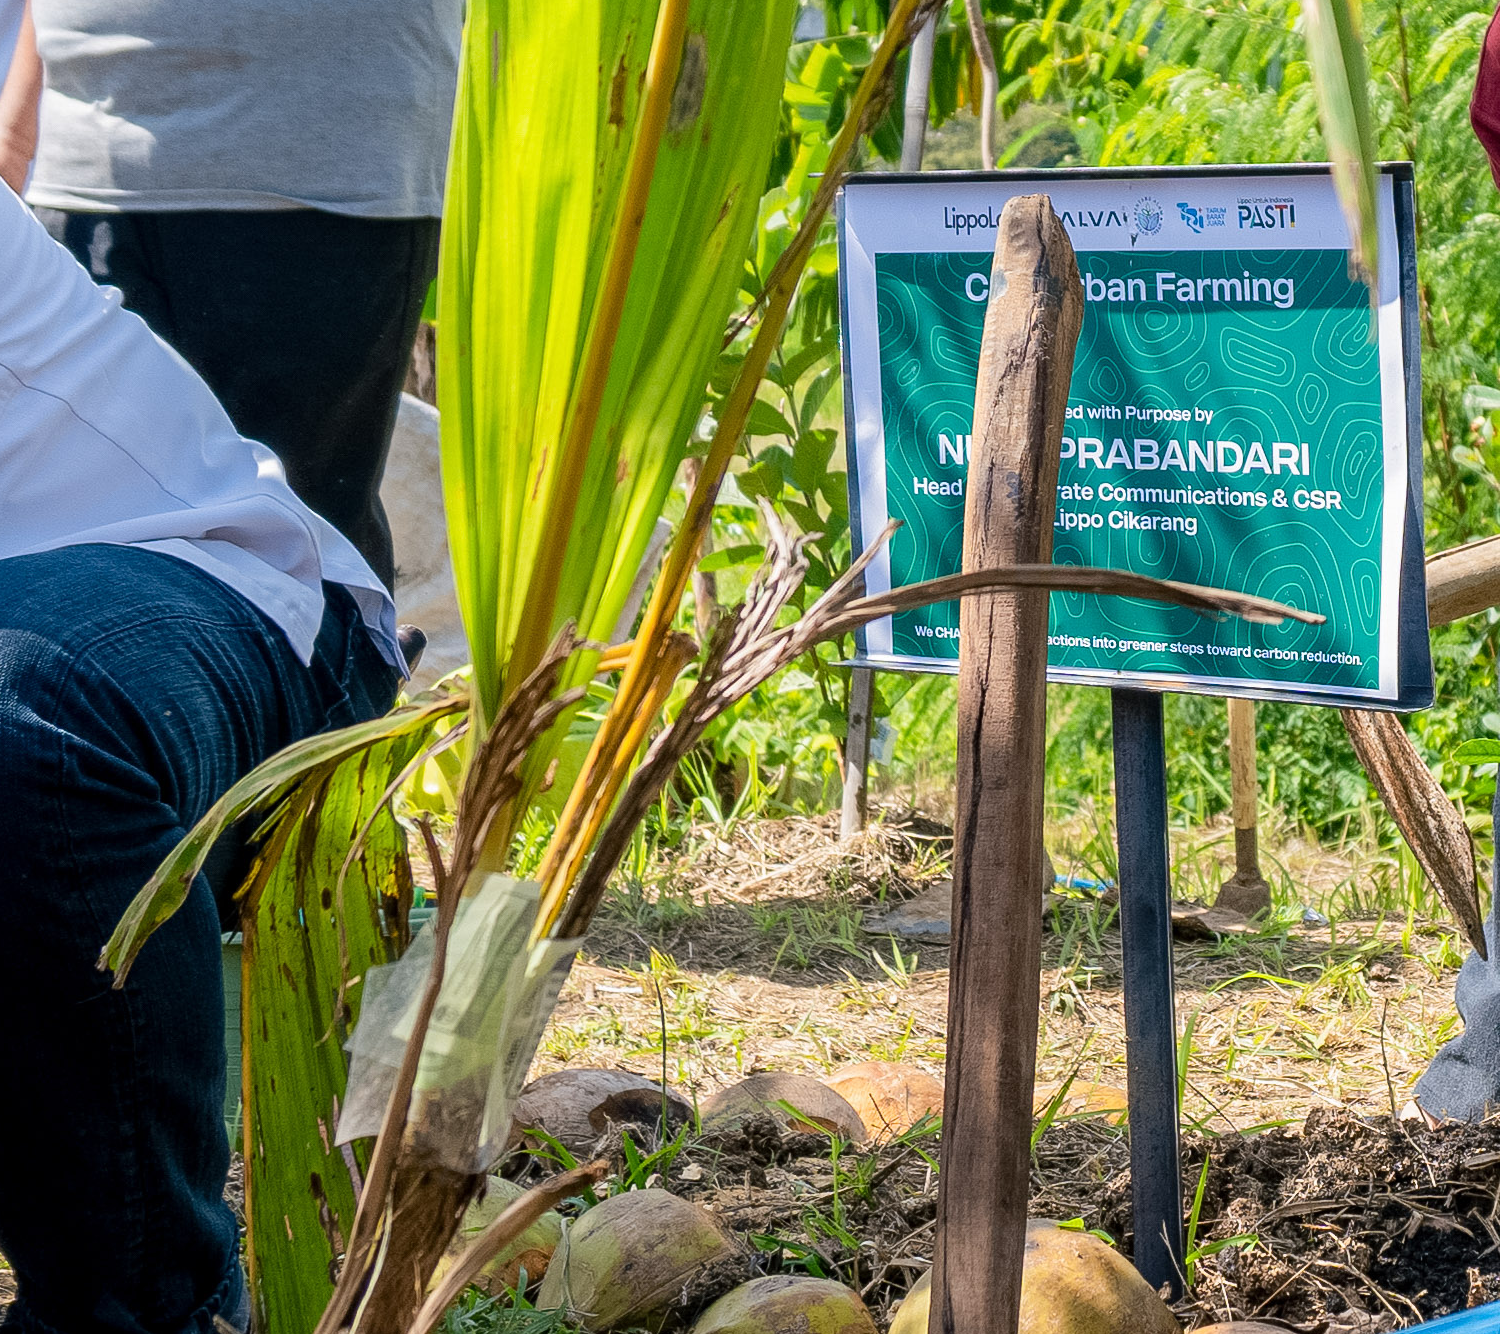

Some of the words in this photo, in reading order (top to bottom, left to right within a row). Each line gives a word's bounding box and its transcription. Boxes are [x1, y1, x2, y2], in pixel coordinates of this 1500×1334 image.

[1155, 270, 1295, 309] Farming
[1086, 404, 1121, 420] with
[1125, 405, 1191, 423] Purpose
[1194, 406, 1214, 425] by
[913, 477, 963, 496] Head
[1098, 482, 1267, 507] Communications
[1271, 488, 1289, 508] &
[1293, 489, 1342, 509] CSR
[1108, 510, 1198, 536] Cikarang
[914, 624, 934, 637] We
[1047, 633, 1091, 648] actions
[1092, 635, 1117, 650] into
[1118, 638, 1168, 653] greener
[1169, 640, 1205, 656] steps
[1207, 641, 1252, 658] toward
[1253, 645, 1299, 662] carbon
[1301, 647, 1364, 666] reduction.
